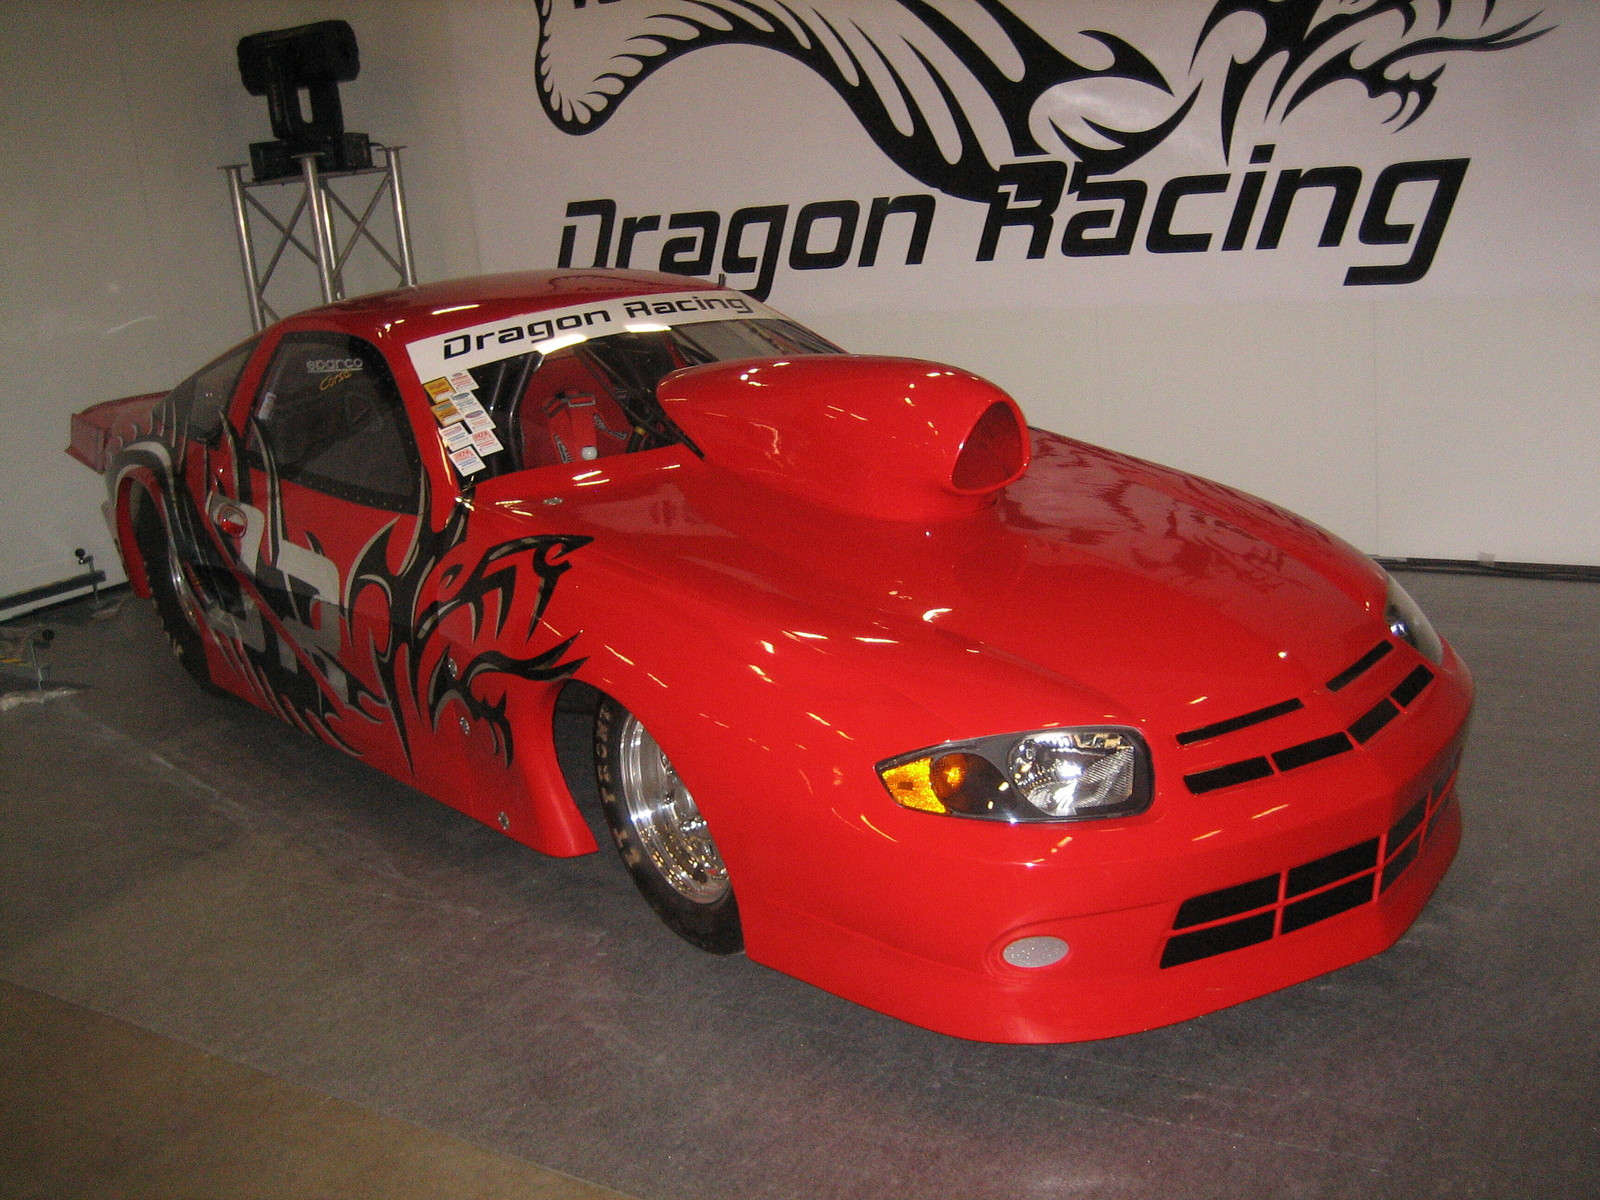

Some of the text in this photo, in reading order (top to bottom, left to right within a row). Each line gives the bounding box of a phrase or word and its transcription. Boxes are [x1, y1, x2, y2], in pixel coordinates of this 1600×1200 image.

[557, 144, 1471, 301] Dragon Racing
[443, 296, 754, 360] Dragon Racing
